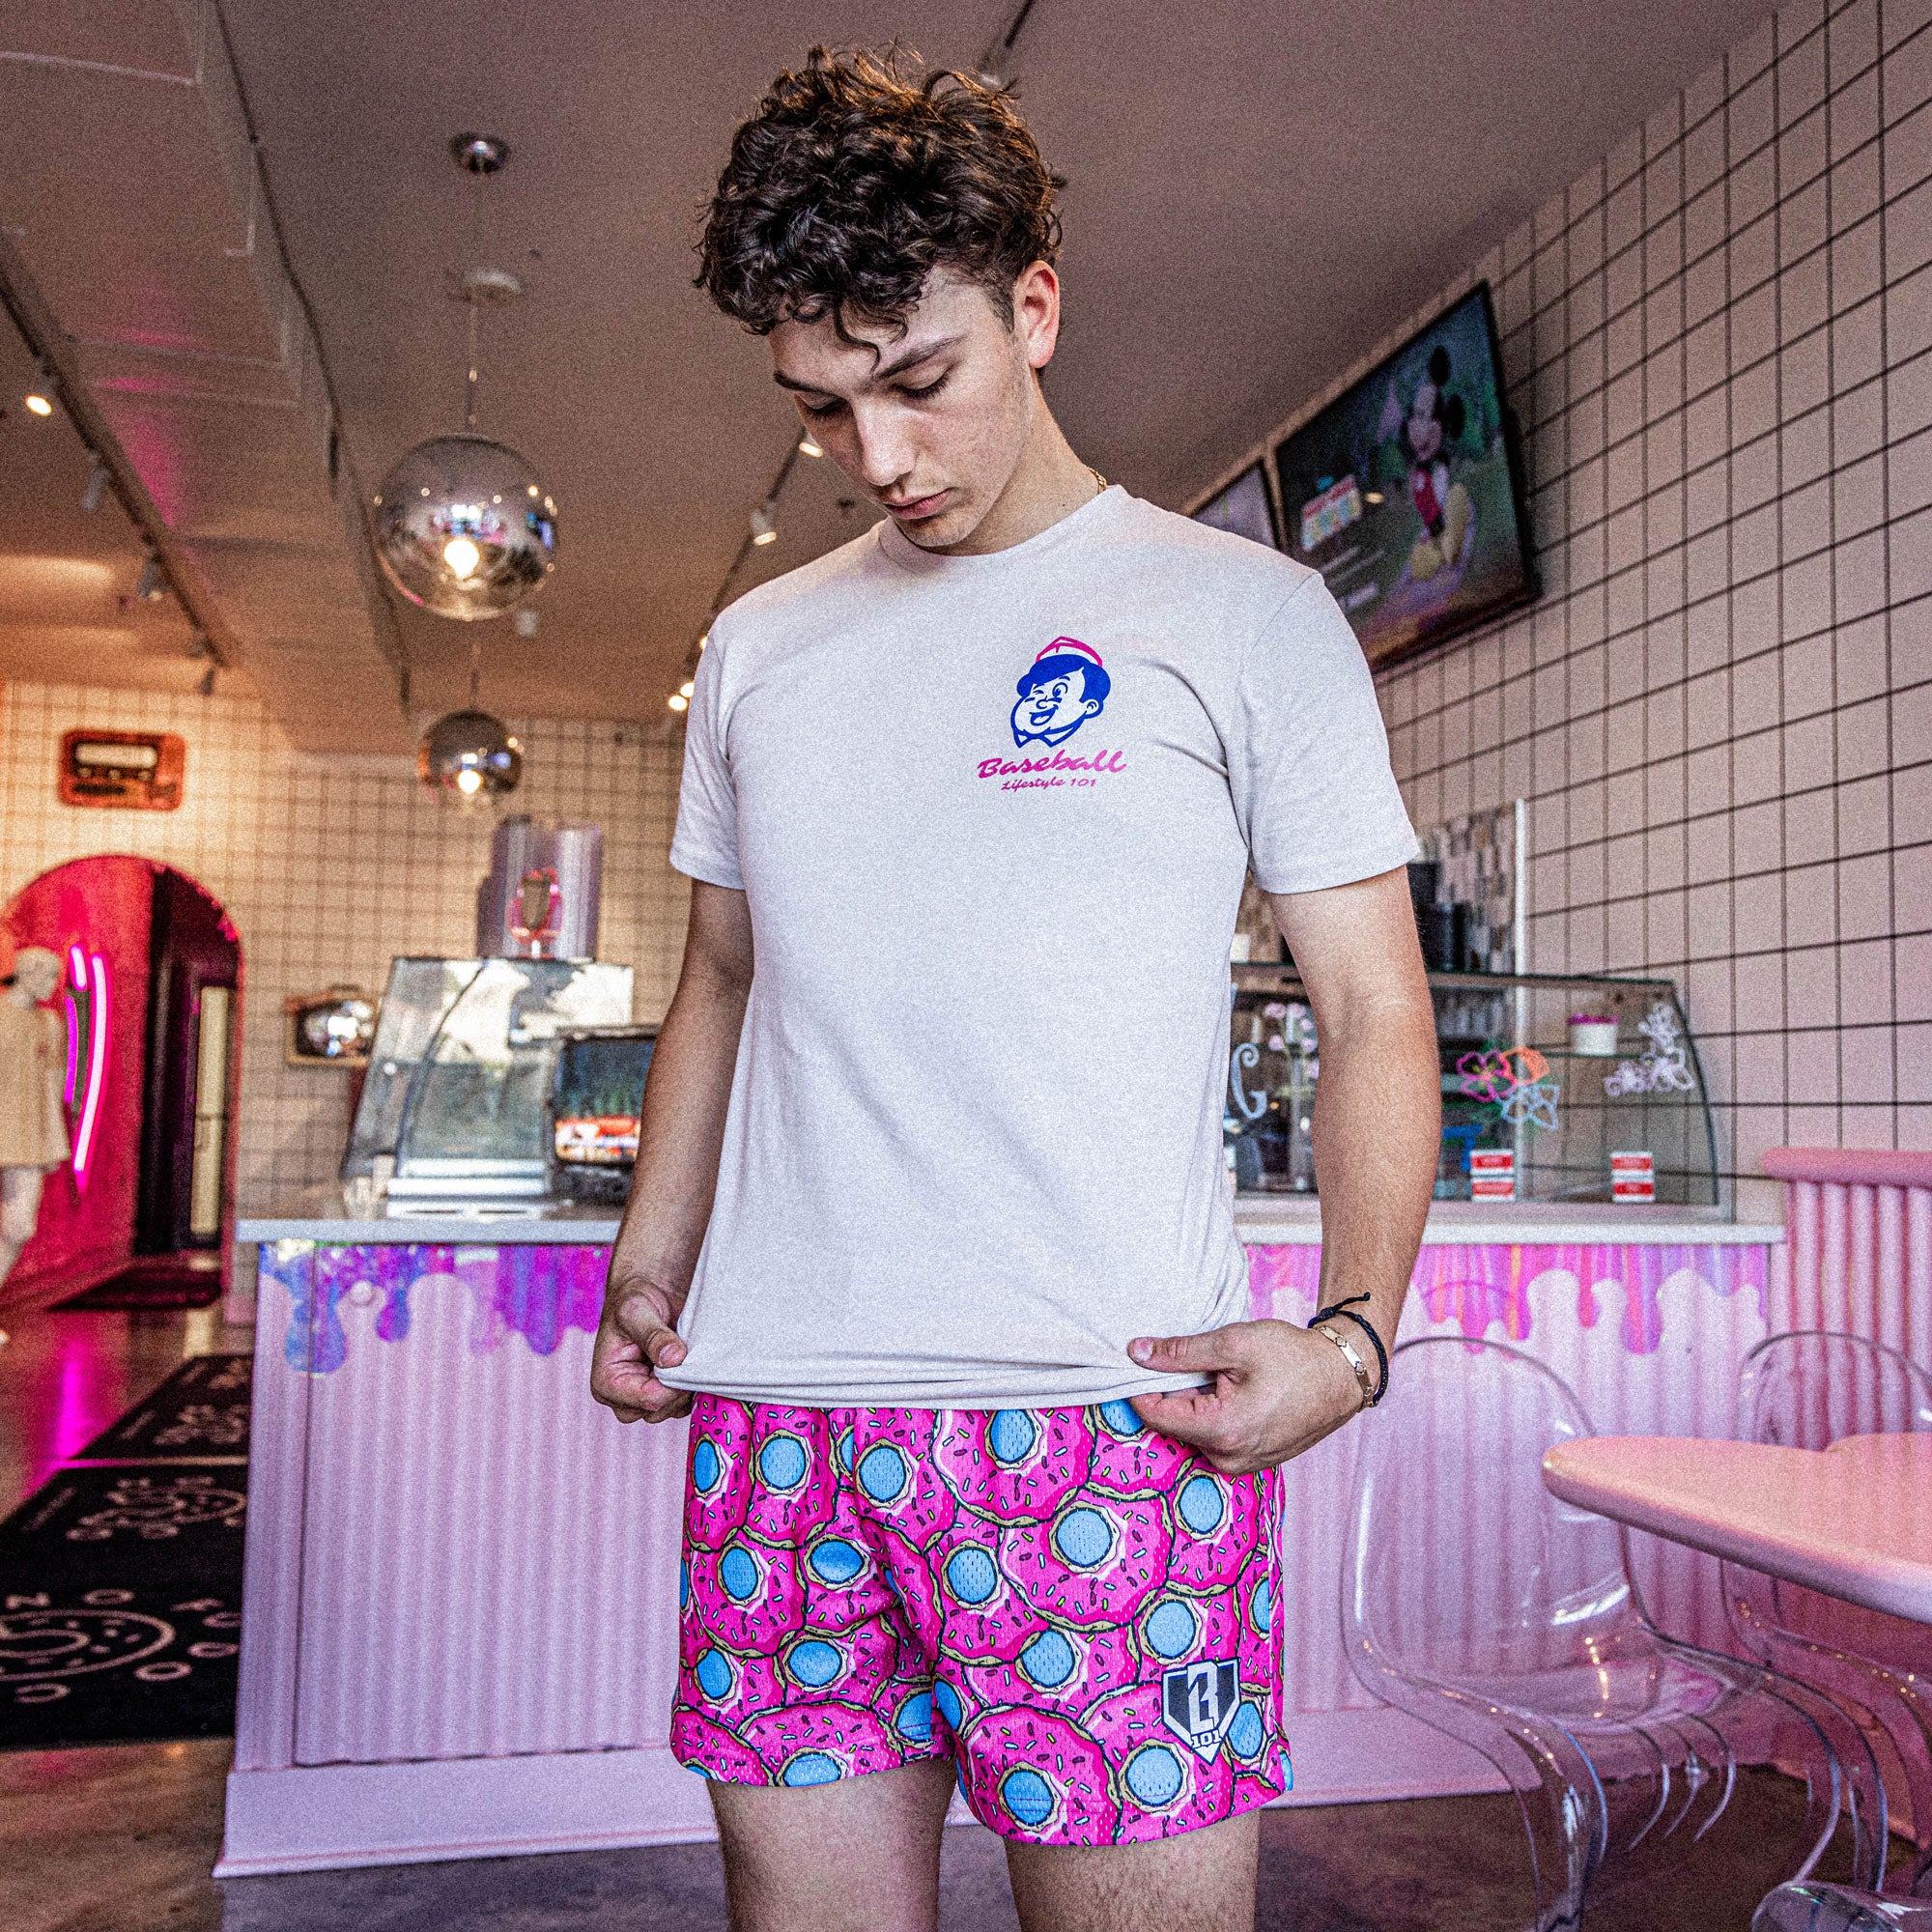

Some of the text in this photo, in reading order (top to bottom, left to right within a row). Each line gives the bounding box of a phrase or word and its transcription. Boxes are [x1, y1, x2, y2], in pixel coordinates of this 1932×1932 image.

[978, 749, 1127, 779] Baseball
[1001, 777, 1096, 792] Lifestyle 101
[1190, 1728, 1222, 1748] 101
